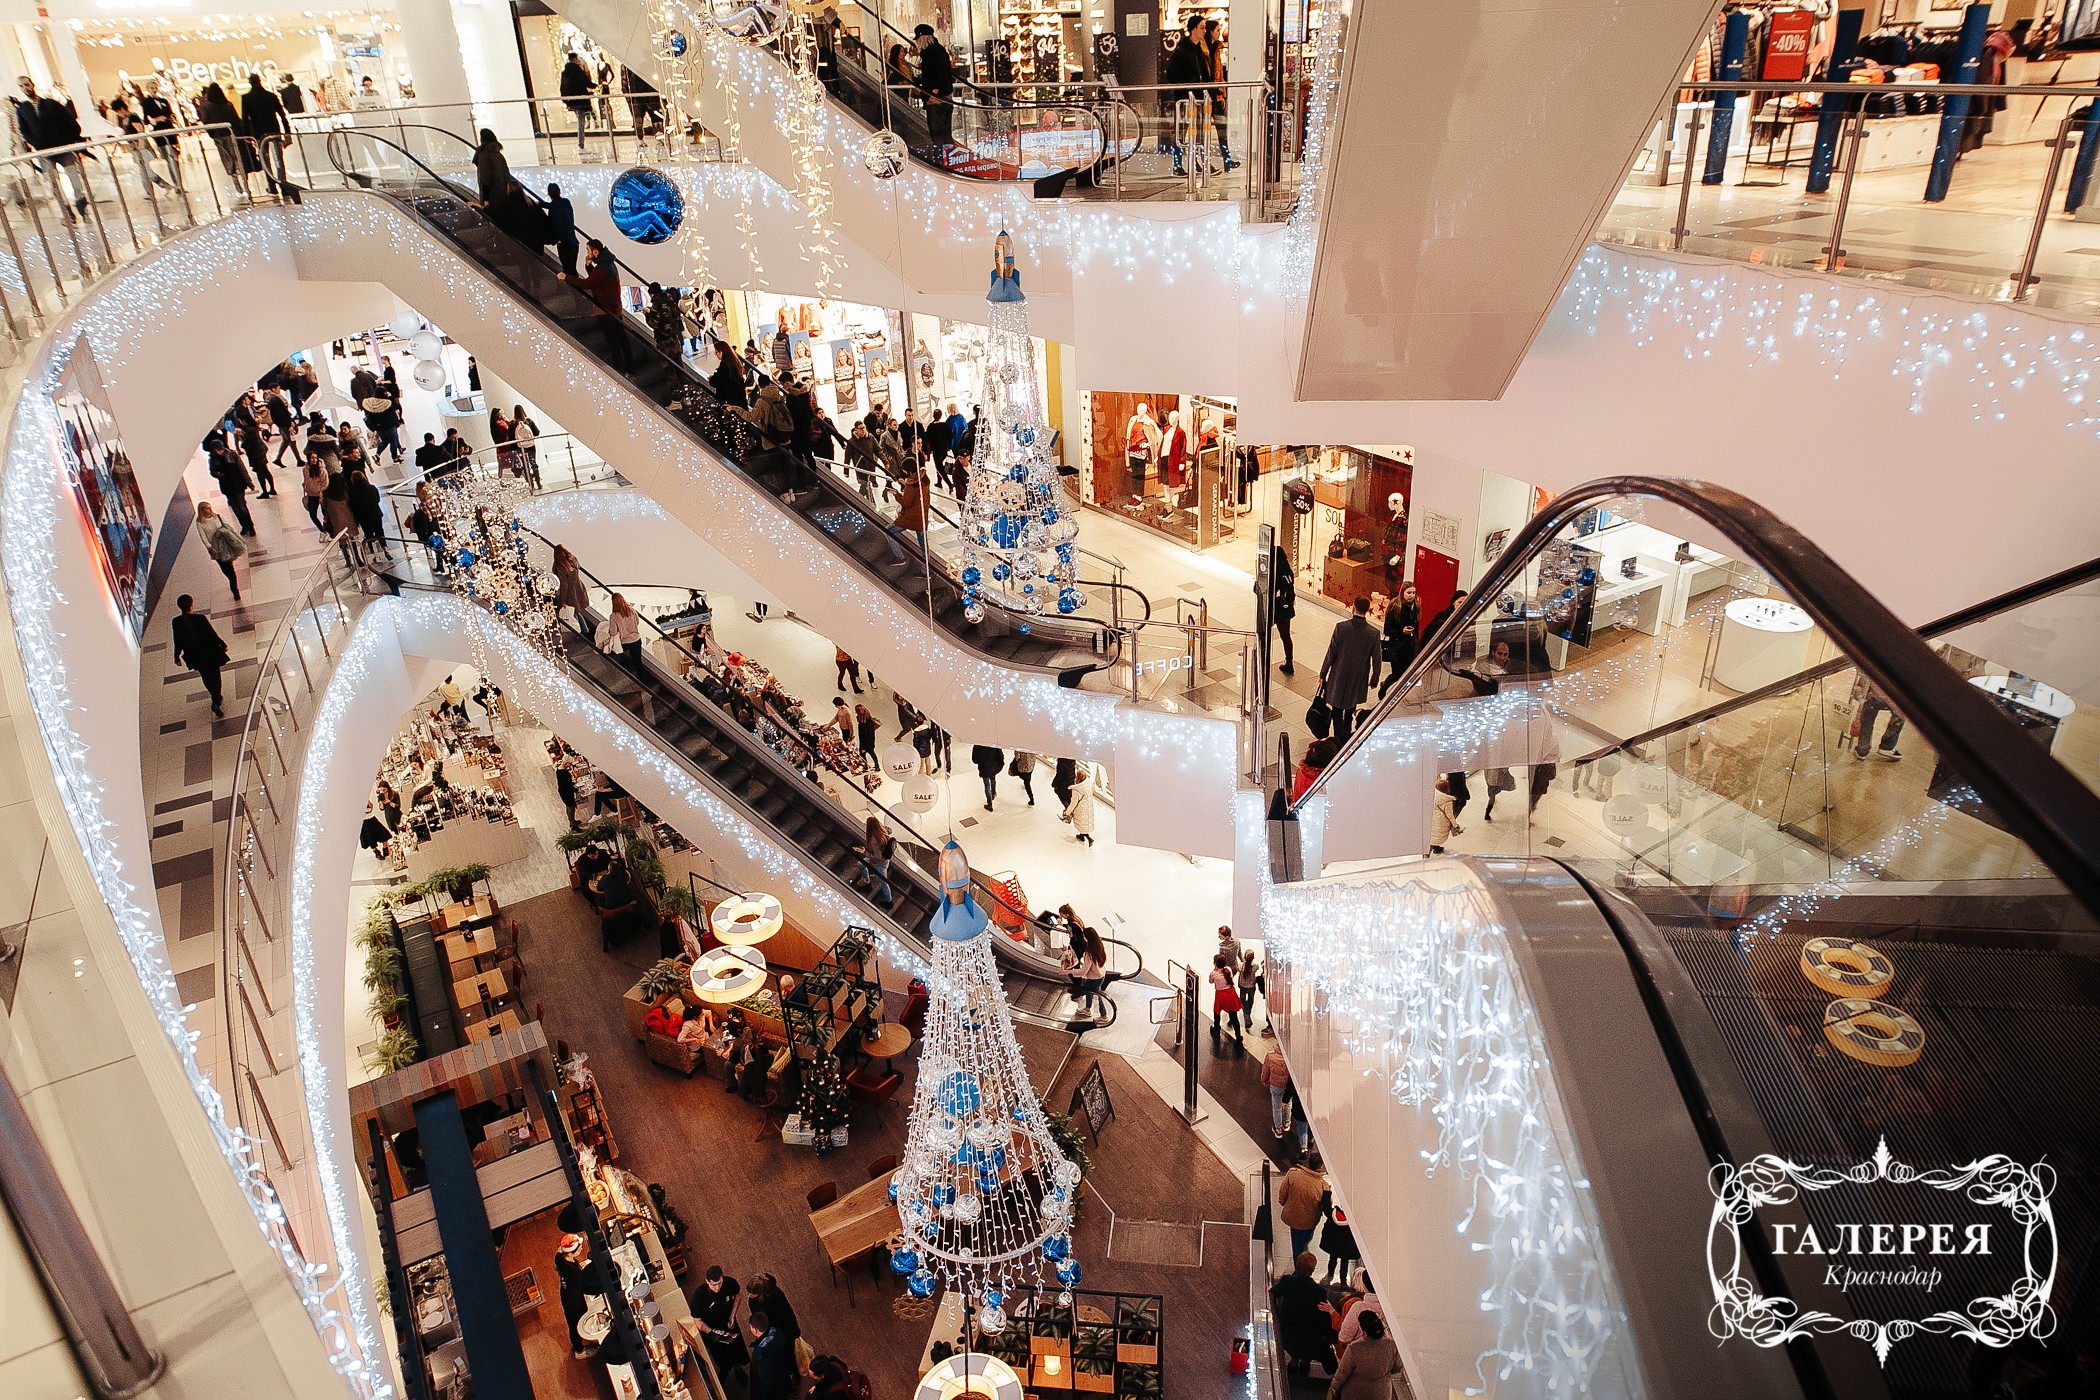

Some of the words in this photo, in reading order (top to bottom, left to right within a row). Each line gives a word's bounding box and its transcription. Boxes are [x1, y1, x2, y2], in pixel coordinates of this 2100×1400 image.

[1771, 34, 1806, 52] -40%
[414, 374, 430, 383] ALE
[1293, 498, 1311, 512] -50%
[893, 761, 915, 771] SALE
[914, 793, 935, 801] SALE
